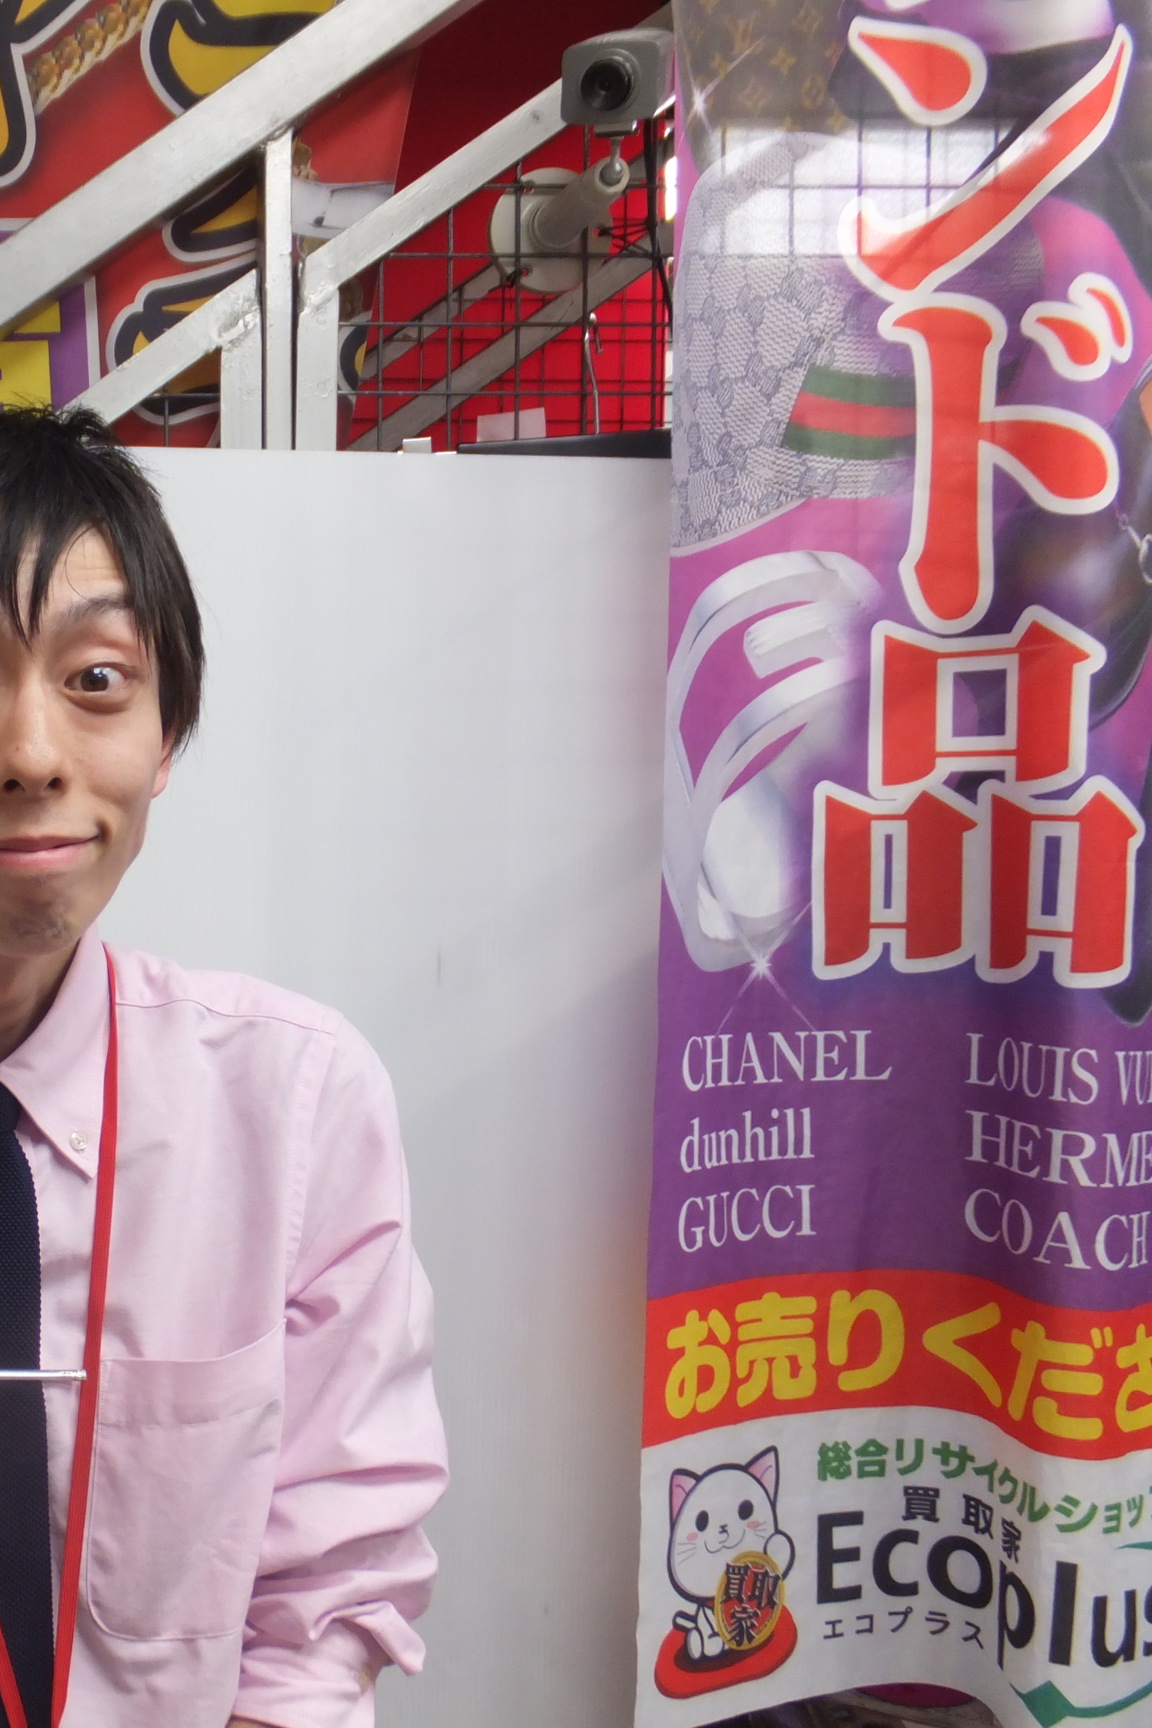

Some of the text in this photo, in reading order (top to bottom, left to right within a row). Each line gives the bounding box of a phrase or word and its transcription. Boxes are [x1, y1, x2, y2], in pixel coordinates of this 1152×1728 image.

[680, 1029, 893, 1093] CHANEL
[964, 1032, 1099, 1106] LOUIS
[679, 1106, 815, 1173] dunhill
[677, 1184, 817, 1253] GUCCI
[963, 1187, 1151, 1272] COACH
[817, 1438, 1152, 1535] 総合リサイクルショッ
[901, 1485, 1022, 1564] 買取家
[816, 1510, 1152, 1671] Ecoplu
[823, 1610, 985, 1650] エコプラス
